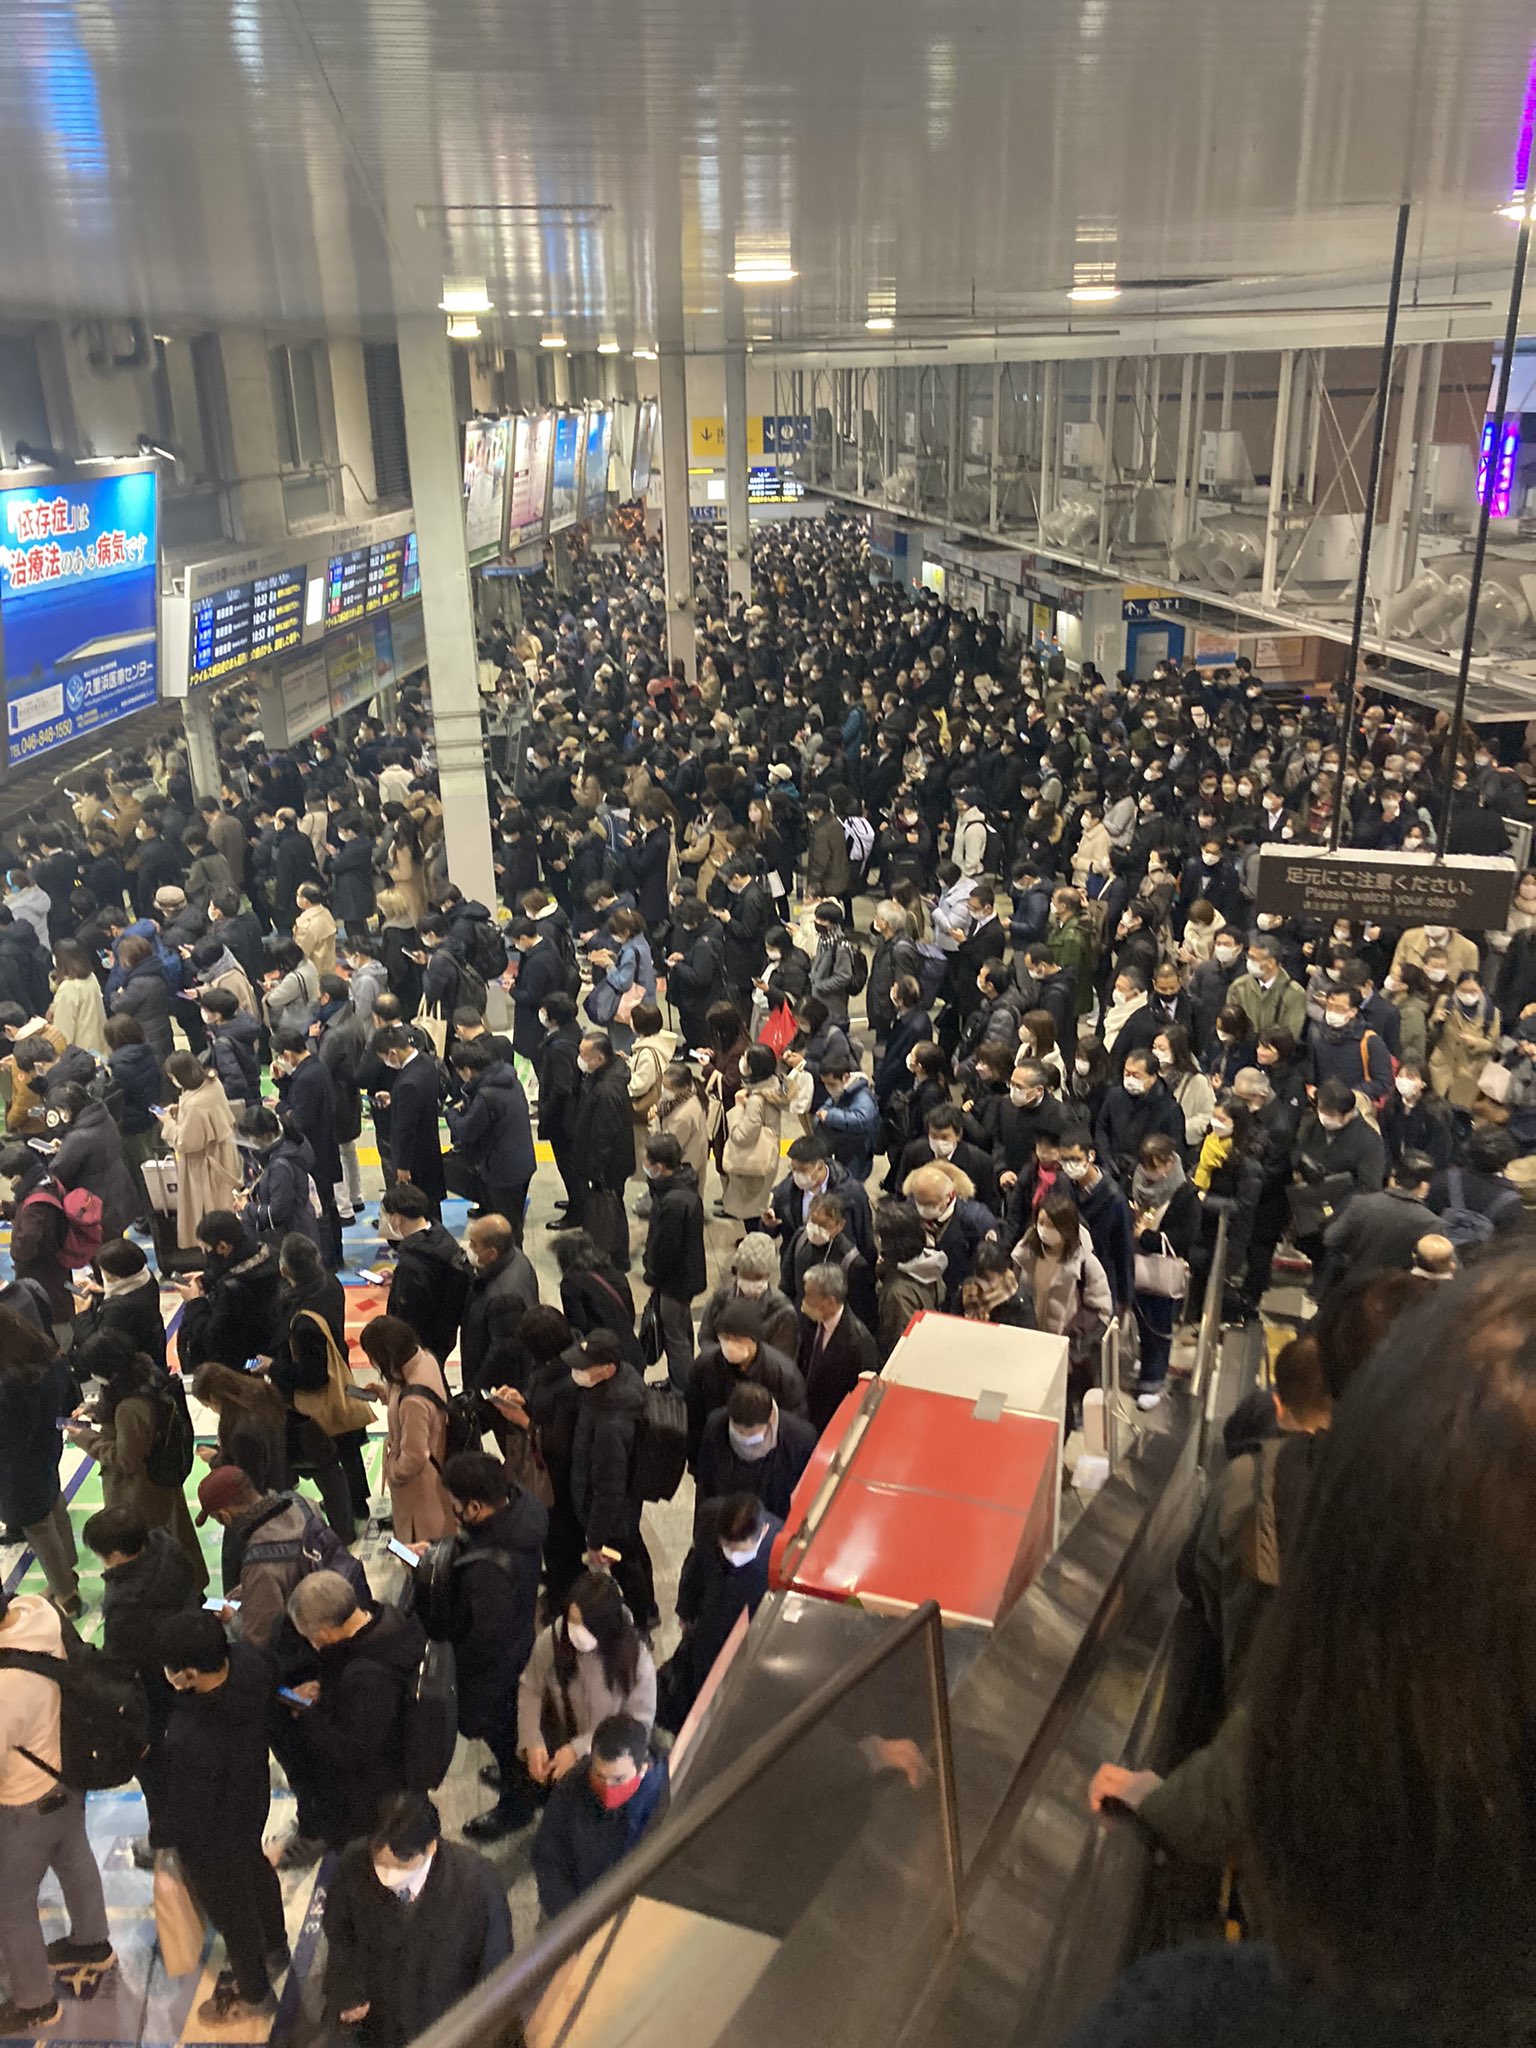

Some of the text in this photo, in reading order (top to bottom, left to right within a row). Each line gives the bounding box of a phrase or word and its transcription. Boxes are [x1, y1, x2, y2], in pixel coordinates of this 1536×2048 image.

[9, 532, 147, 586] 治療法のある病気です
[1285, 866, 1473, 896] 足元にご注意ください。
[1305, 887, 1348, 901] Please
[1352, 891, 1391, 903] watch
[1394, 894, 1424, 907] your
